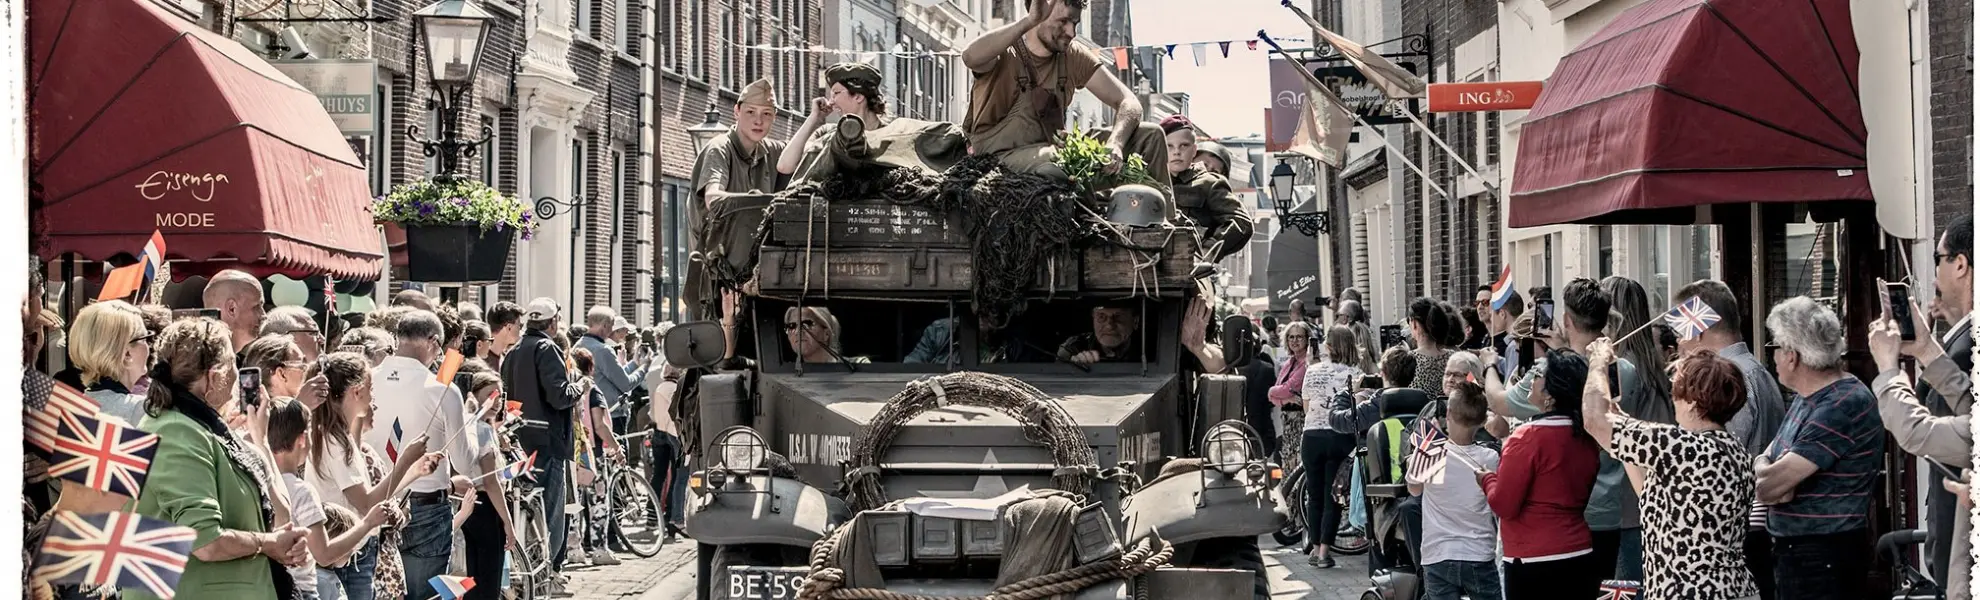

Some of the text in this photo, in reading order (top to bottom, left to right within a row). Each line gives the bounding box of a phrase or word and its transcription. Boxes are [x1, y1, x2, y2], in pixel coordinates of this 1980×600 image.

[1459, 91, 1491, 105] ING
[135, 171, 229, 202] Eisenga
[156, 213, 215, 227] MODE
